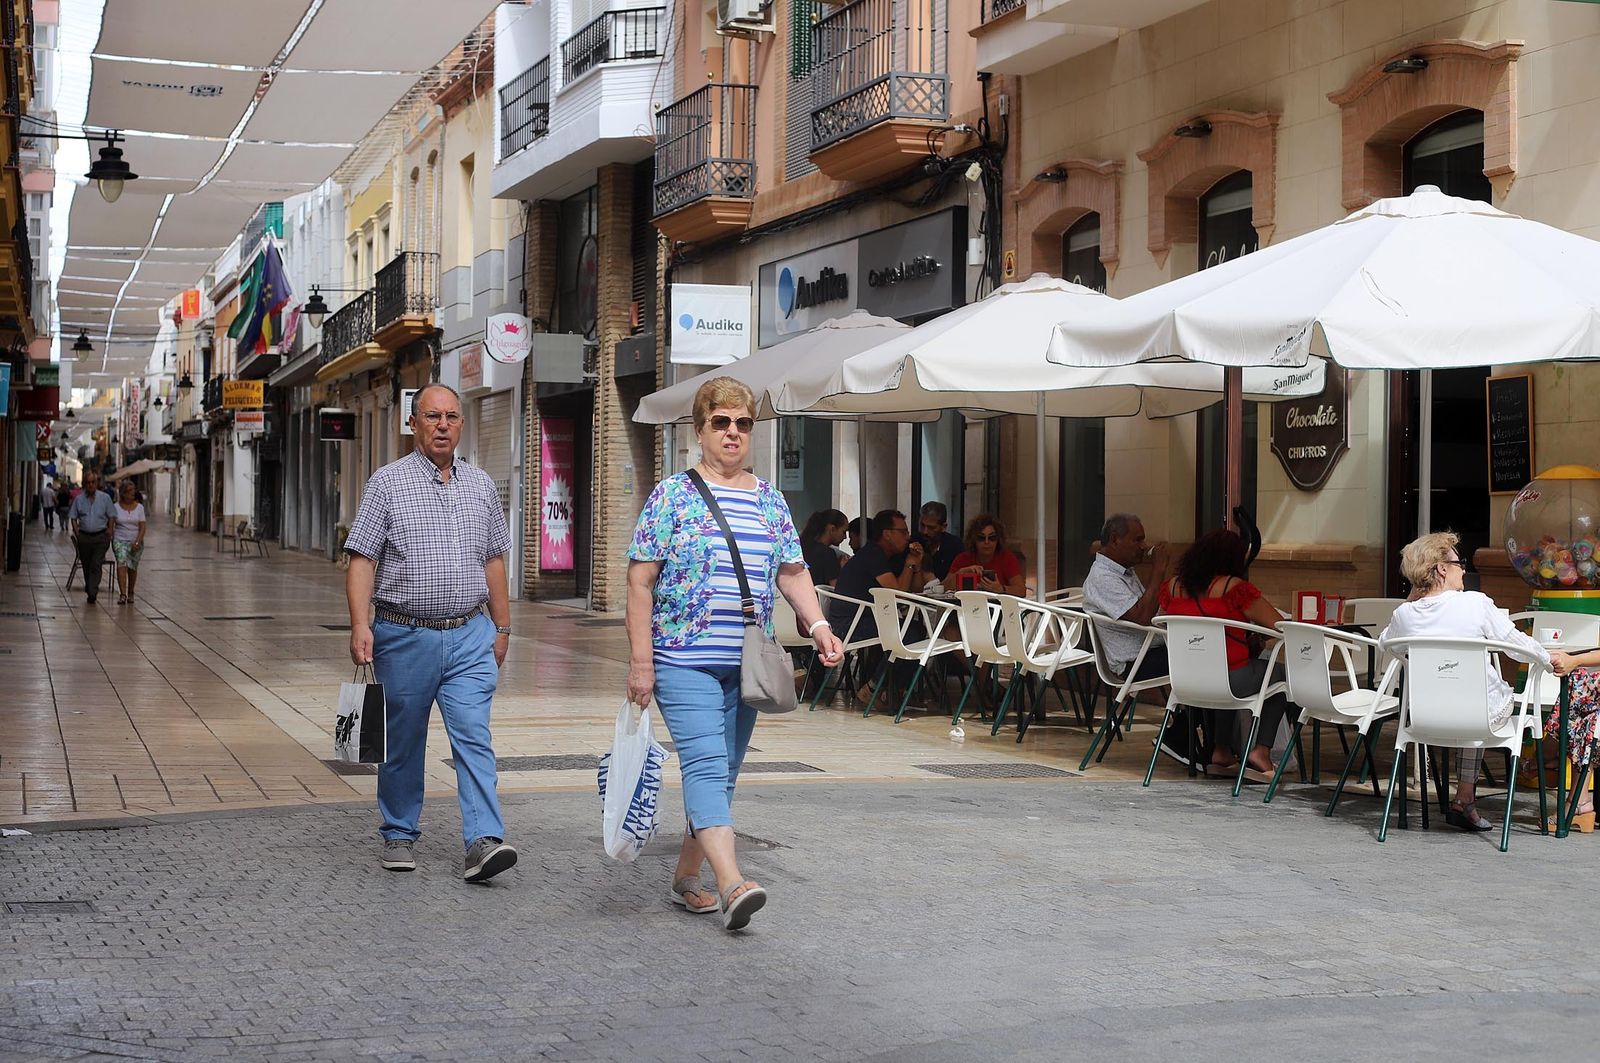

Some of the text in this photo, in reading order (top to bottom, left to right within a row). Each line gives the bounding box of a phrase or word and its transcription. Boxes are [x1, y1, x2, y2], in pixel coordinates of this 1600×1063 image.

[795, 266, 848, 309] Audika
[696, 318, 743, 331] Audika
[224, 382, 262, 393] ALDEMAR
[1286, 404, 1338, 429] Chocolate
[1288, 445, 1327, 460] CHURROS
[547, 501, 569, 521] 70%
